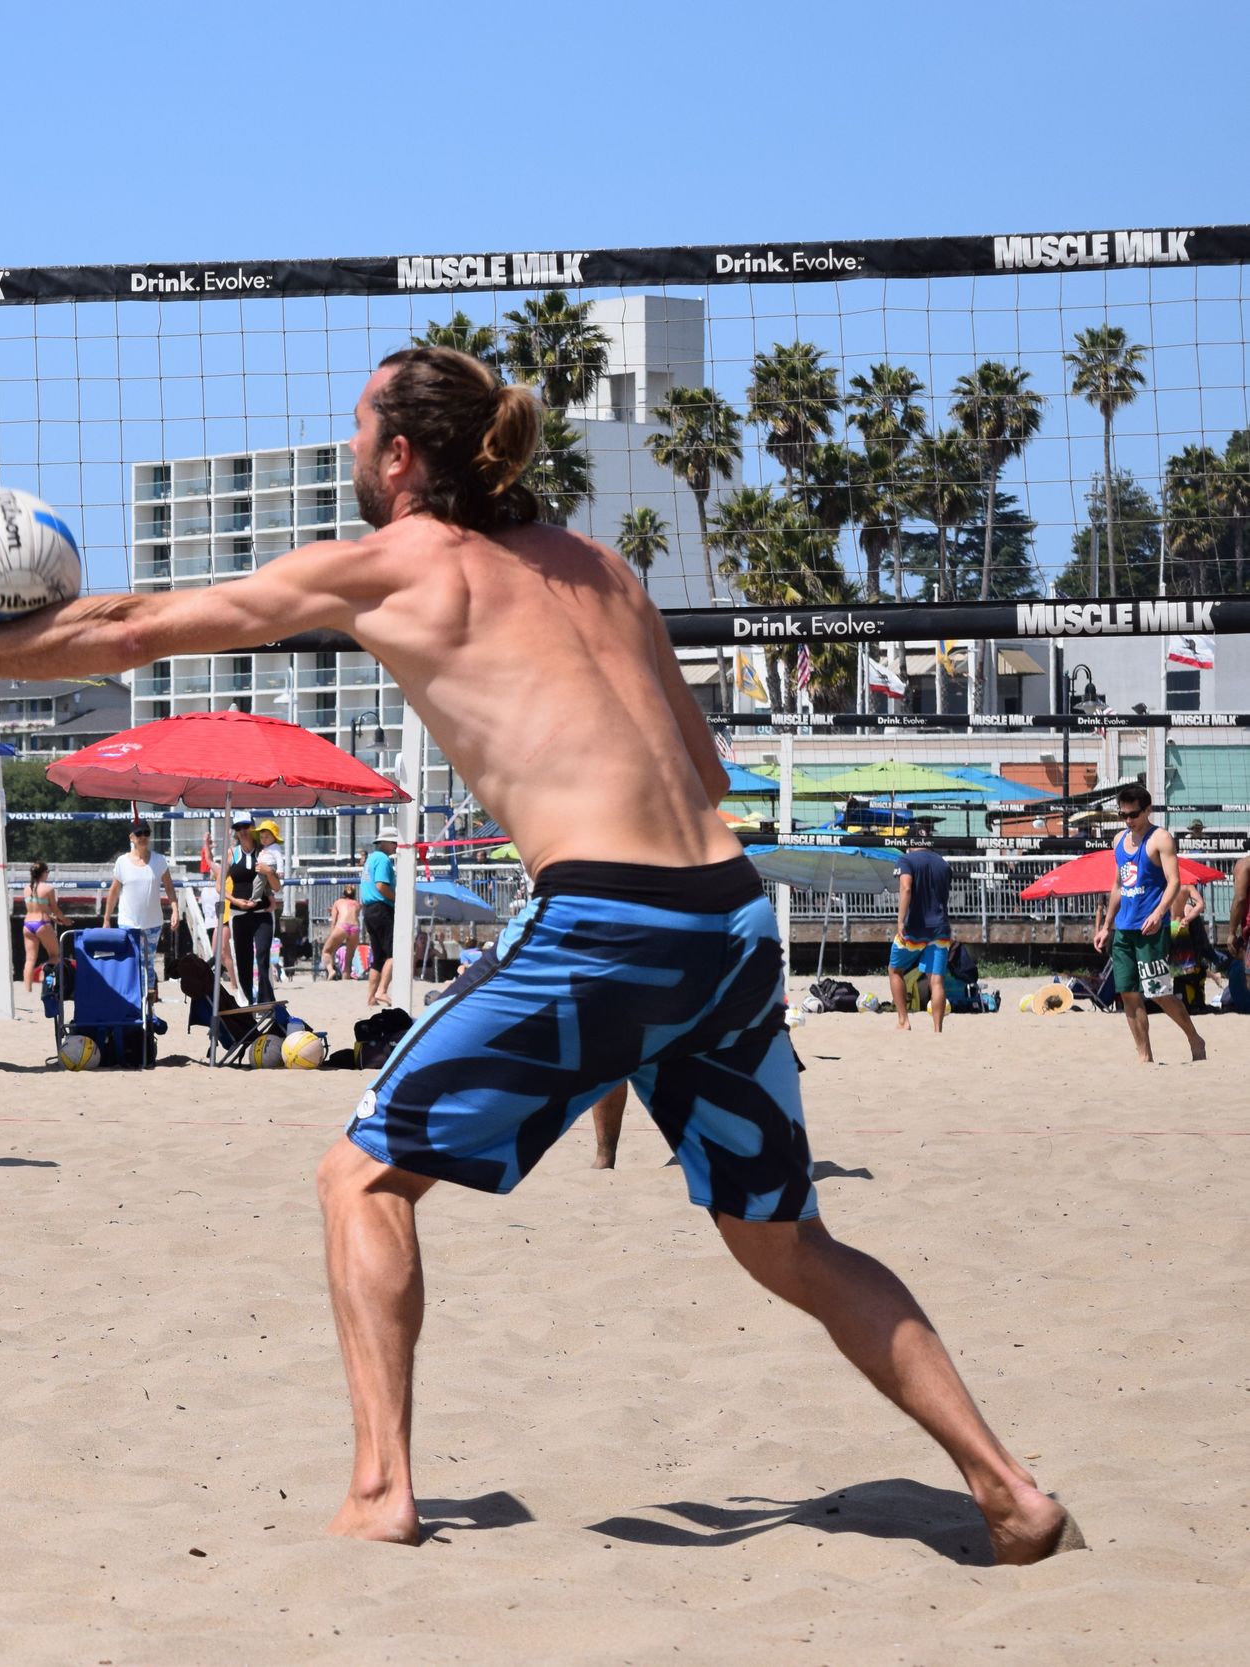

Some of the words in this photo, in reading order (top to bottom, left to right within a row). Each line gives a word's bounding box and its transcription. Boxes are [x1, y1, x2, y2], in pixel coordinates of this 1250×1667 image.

[994, 233, 1109, 269] MUSCLE
[397, 255, 506, 288] MUSCLE
[716, 252, 790, 274] Drink.
[130, 271, 201, 292] Drink.
[734, 615, 807, 638] Drink.
[1017, 603, 1133, 635] MUSCLE
[771, 714, 808, 725] MUSCLE
[878, 716, 902, 724] Drink.
[969, 715, 1008, 726] MUSCLE
[1078, 717, 1102, 725] Drink.
[1171, 715, 1210, 726] MUSCLE
[272, 808, 340, 817] VOLLEYBALL
[777, 834, 815, 846] MUSCLE
[885, 838, 909, 846] Drink.
[976, 837, 1015, 849] MUSCLE
[1085, 840, 1110, 848] Drink.
[1178, 839, 1217, 850] MUSCLE
